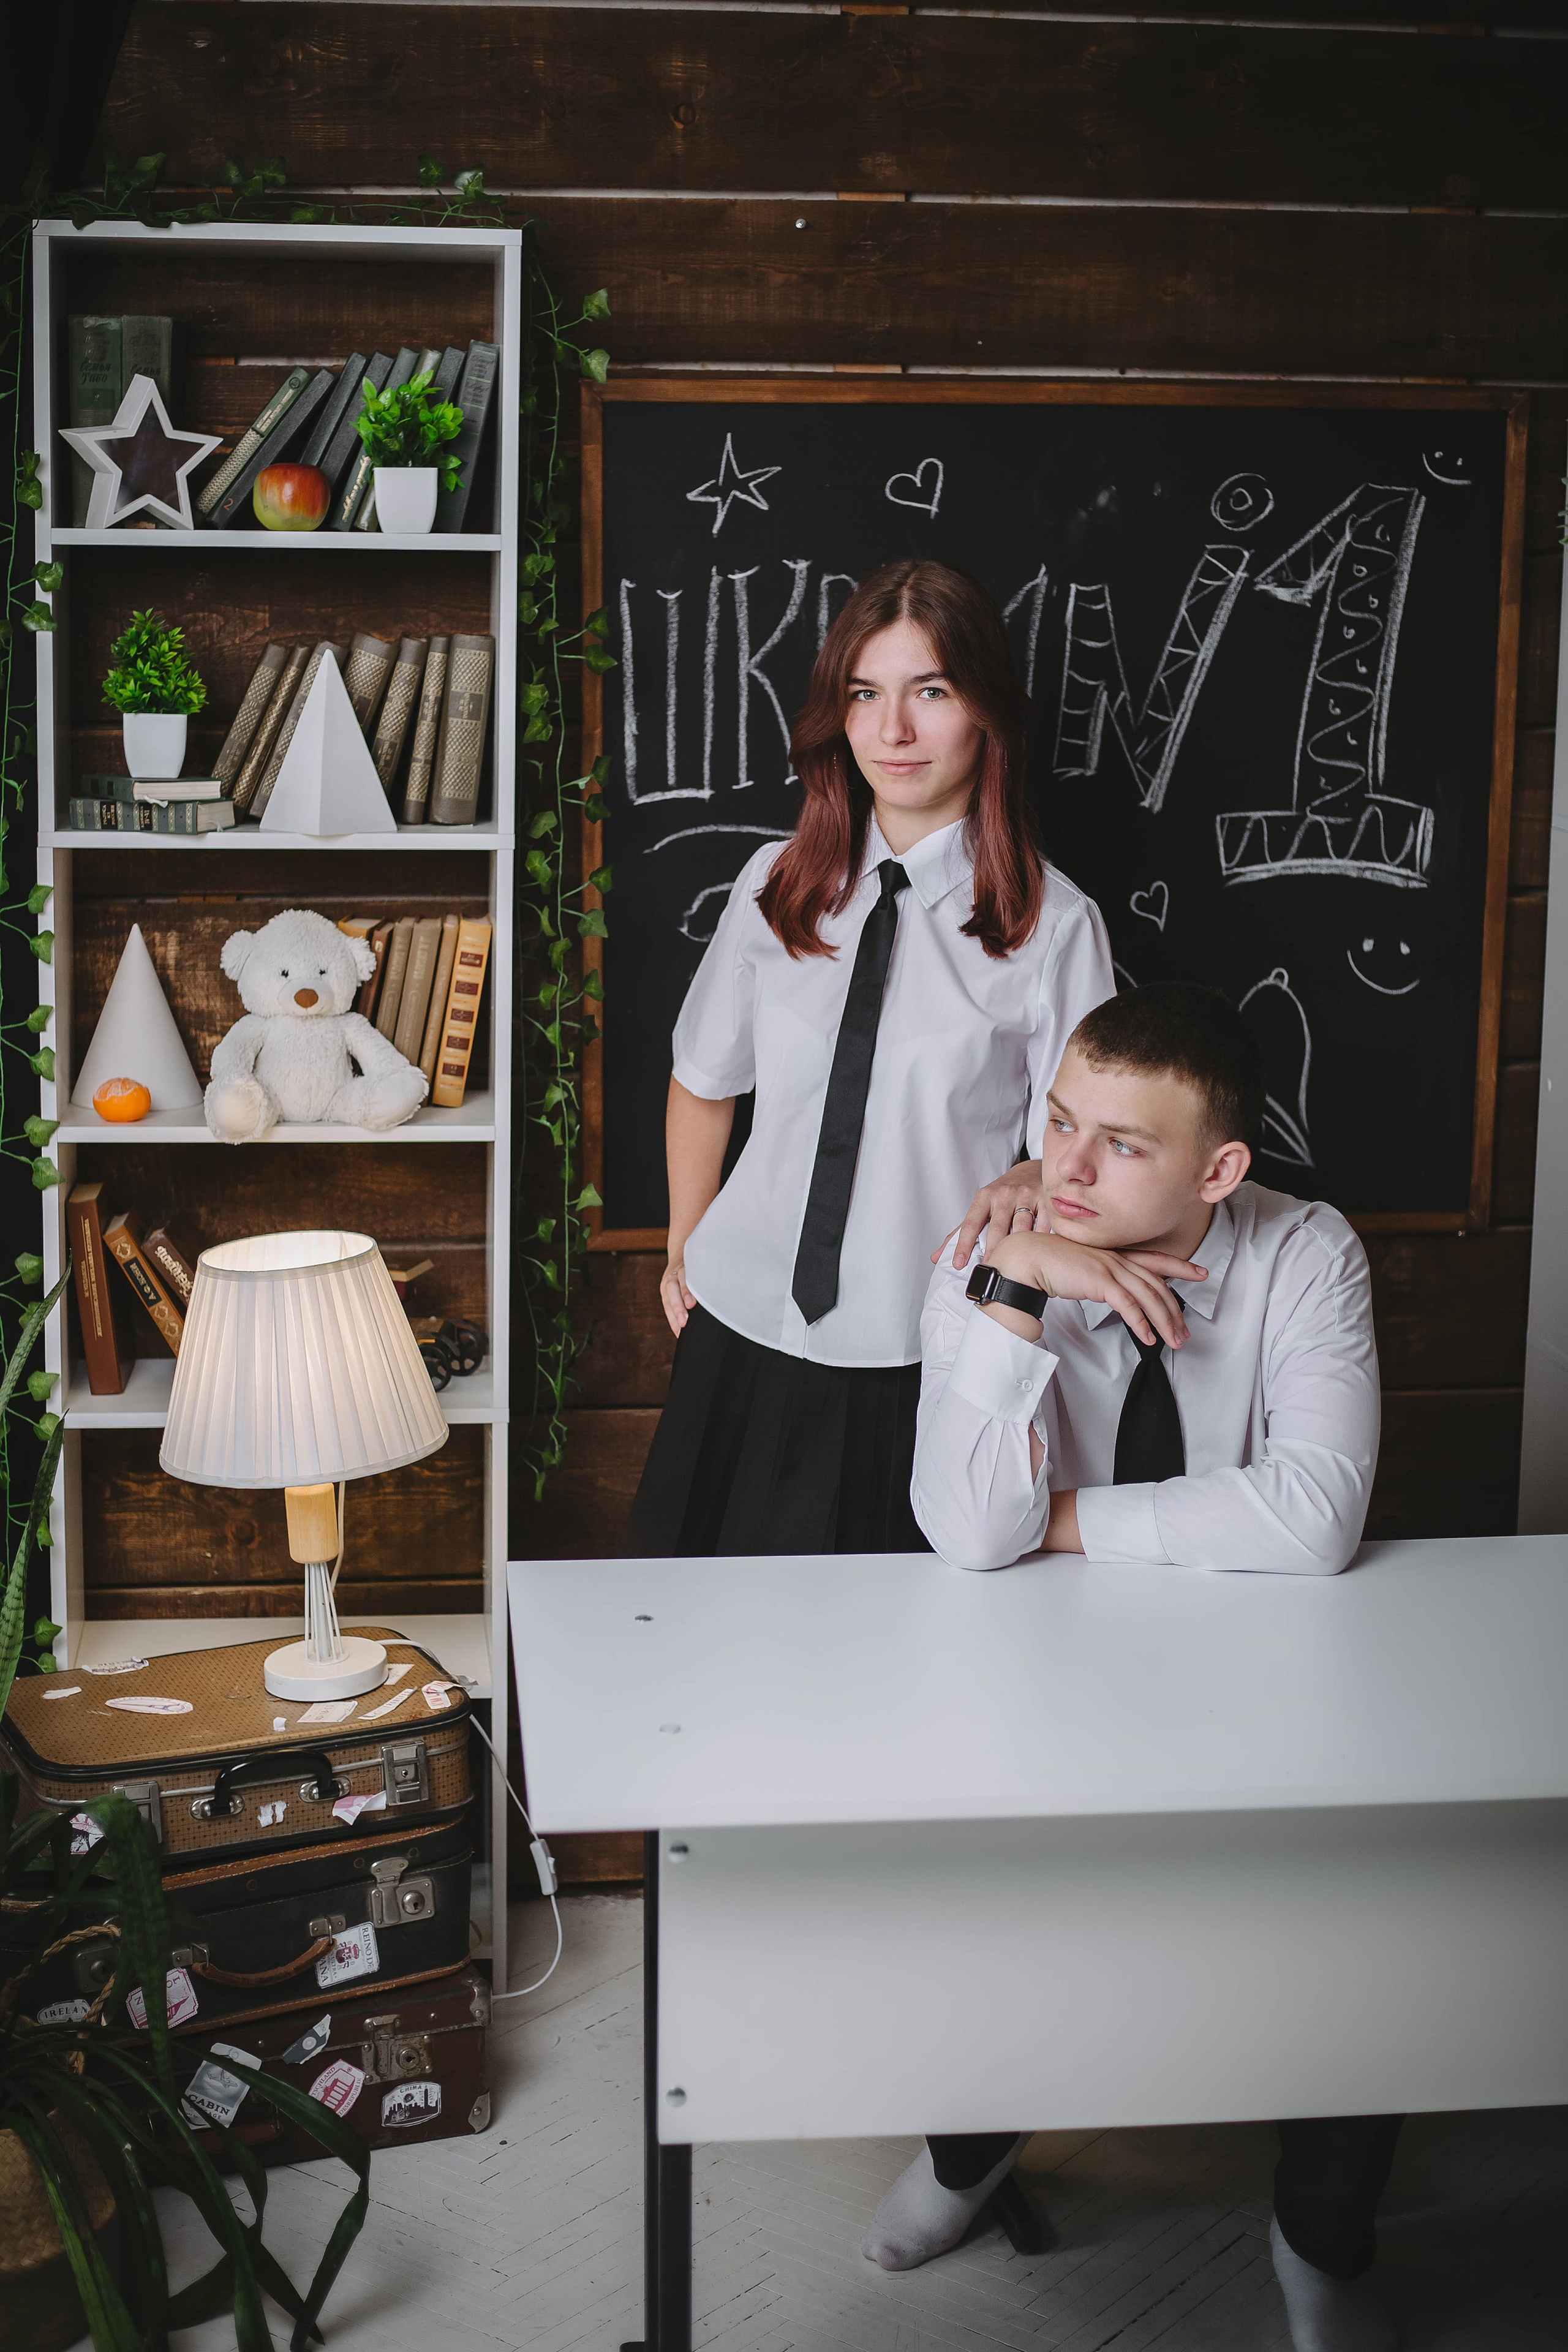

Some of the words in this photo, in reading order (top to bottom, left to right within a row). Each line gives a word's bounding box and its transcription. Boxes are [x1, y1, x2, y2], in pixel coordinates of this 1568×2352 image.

[362, 1927, 372, 1955] REINO
[43, 2006, 88, 2019] IRELAN
[311, 2067, 336, 2097] TSCHLAND
[338, 2076, 362, 2116] DESREPUBLIK
[189, 2094, 230, 2116] CABIN
